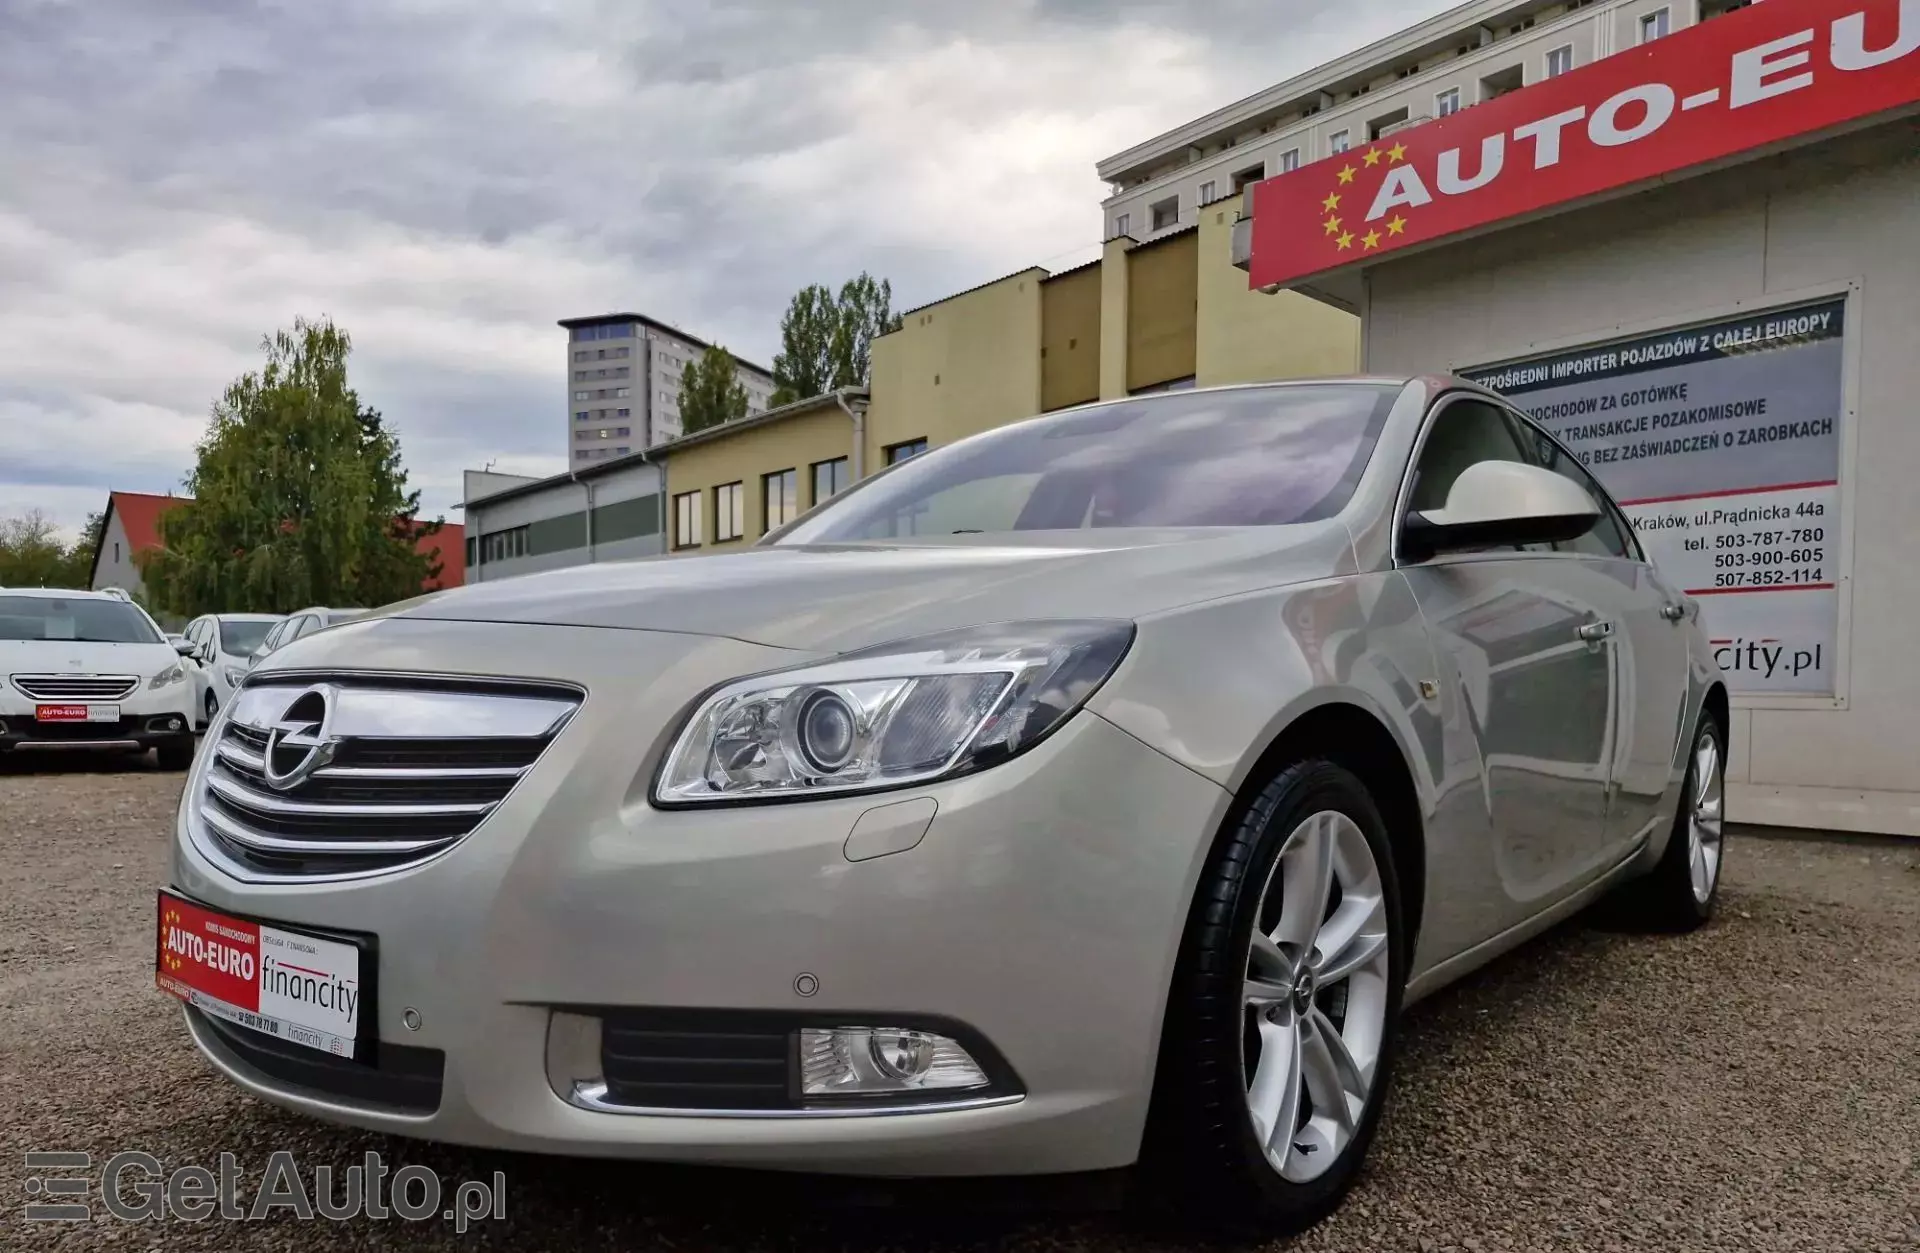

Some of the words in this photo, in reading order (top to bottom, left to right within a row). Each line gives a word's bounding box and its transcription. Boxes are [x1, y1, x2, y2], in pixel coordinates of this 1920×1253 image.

[1475, 366, 1549, 391] EZPOŚREDNI
[1552, 353, 1617, 378] IMPORTER
[1620, 336, 1697, 366] POJAZDÓW
[1699, 335, 1710, 353] Z
[1713, 325, 1764, 350] CAŁEJ
[1766, 311, 1831, 338] EUROPY
[1600, 396, 1617, 411] ZA
[1621, 383, 1688, 406] GOTÓWKĘ
[1566, 414, 1649, 442] TRANSAKCJE
[1652, 398, 1767, 430] POZAKOMISOWE
[1593, 447, 1618, 465] BEZ
[1621, 431, 1719, 461] ZAŚWIADCZEŃ
[1723, 432, 1734, 448] O
[1737, 417, 1833, 446] ZAROBKACH
[1633, 514, 1690, 532] Kraków,
[1694, 505, 1790, 528] ul.Prądnicka
[1795, 502, 1824, 517] 44a
[1684, 537, 1709, 551] tel.
[1715, 528, 1824, 550] 503-787-780
[1714, 547, 1823, 568] 503-900-605
[1714, 567, 1823, 587] 507-852-114
[1714, 638, 1821, 679] city.pl
[168, 926, 254, 980] AUTO-EURO
[262, 955, 358, 1023] financity
[288, 1025, 323, 1048] financity
